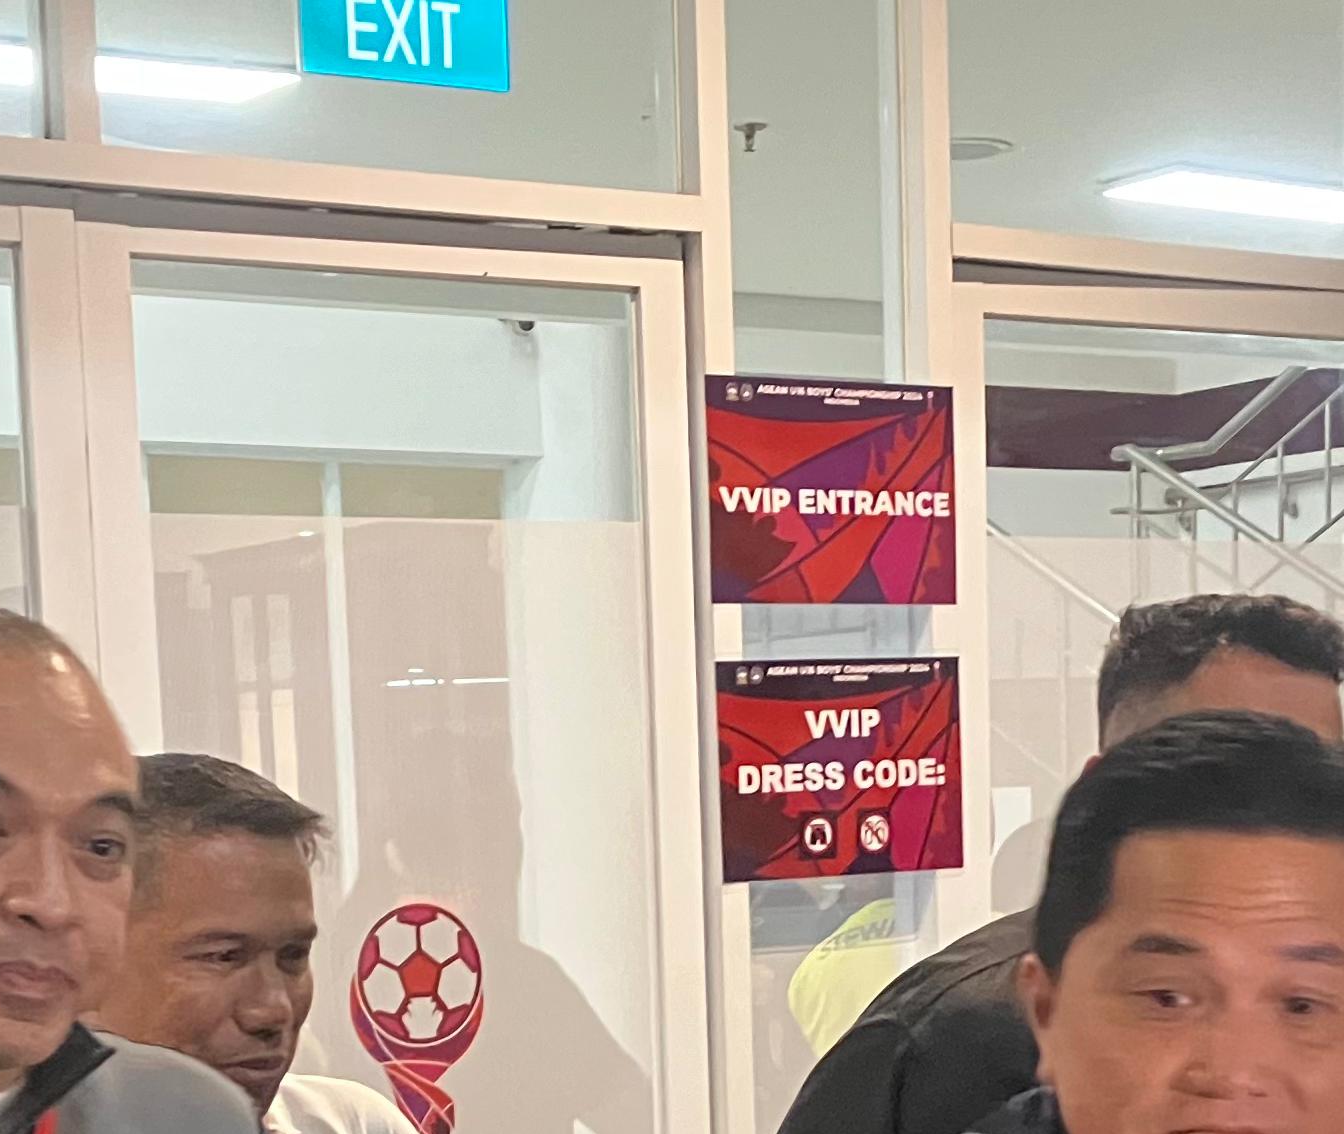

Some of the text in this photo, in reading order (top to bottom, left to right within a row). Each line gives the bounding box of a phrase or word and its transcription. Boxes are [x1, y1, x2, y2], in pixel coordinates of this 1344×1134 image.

[346, 0, 460, 69] EXIT
[718, 486, 951, 517] VVIP ENTRANCE
[804, 708, 881, 738] VVIP
[738, 757, 946, 794] DRESS CODE:
